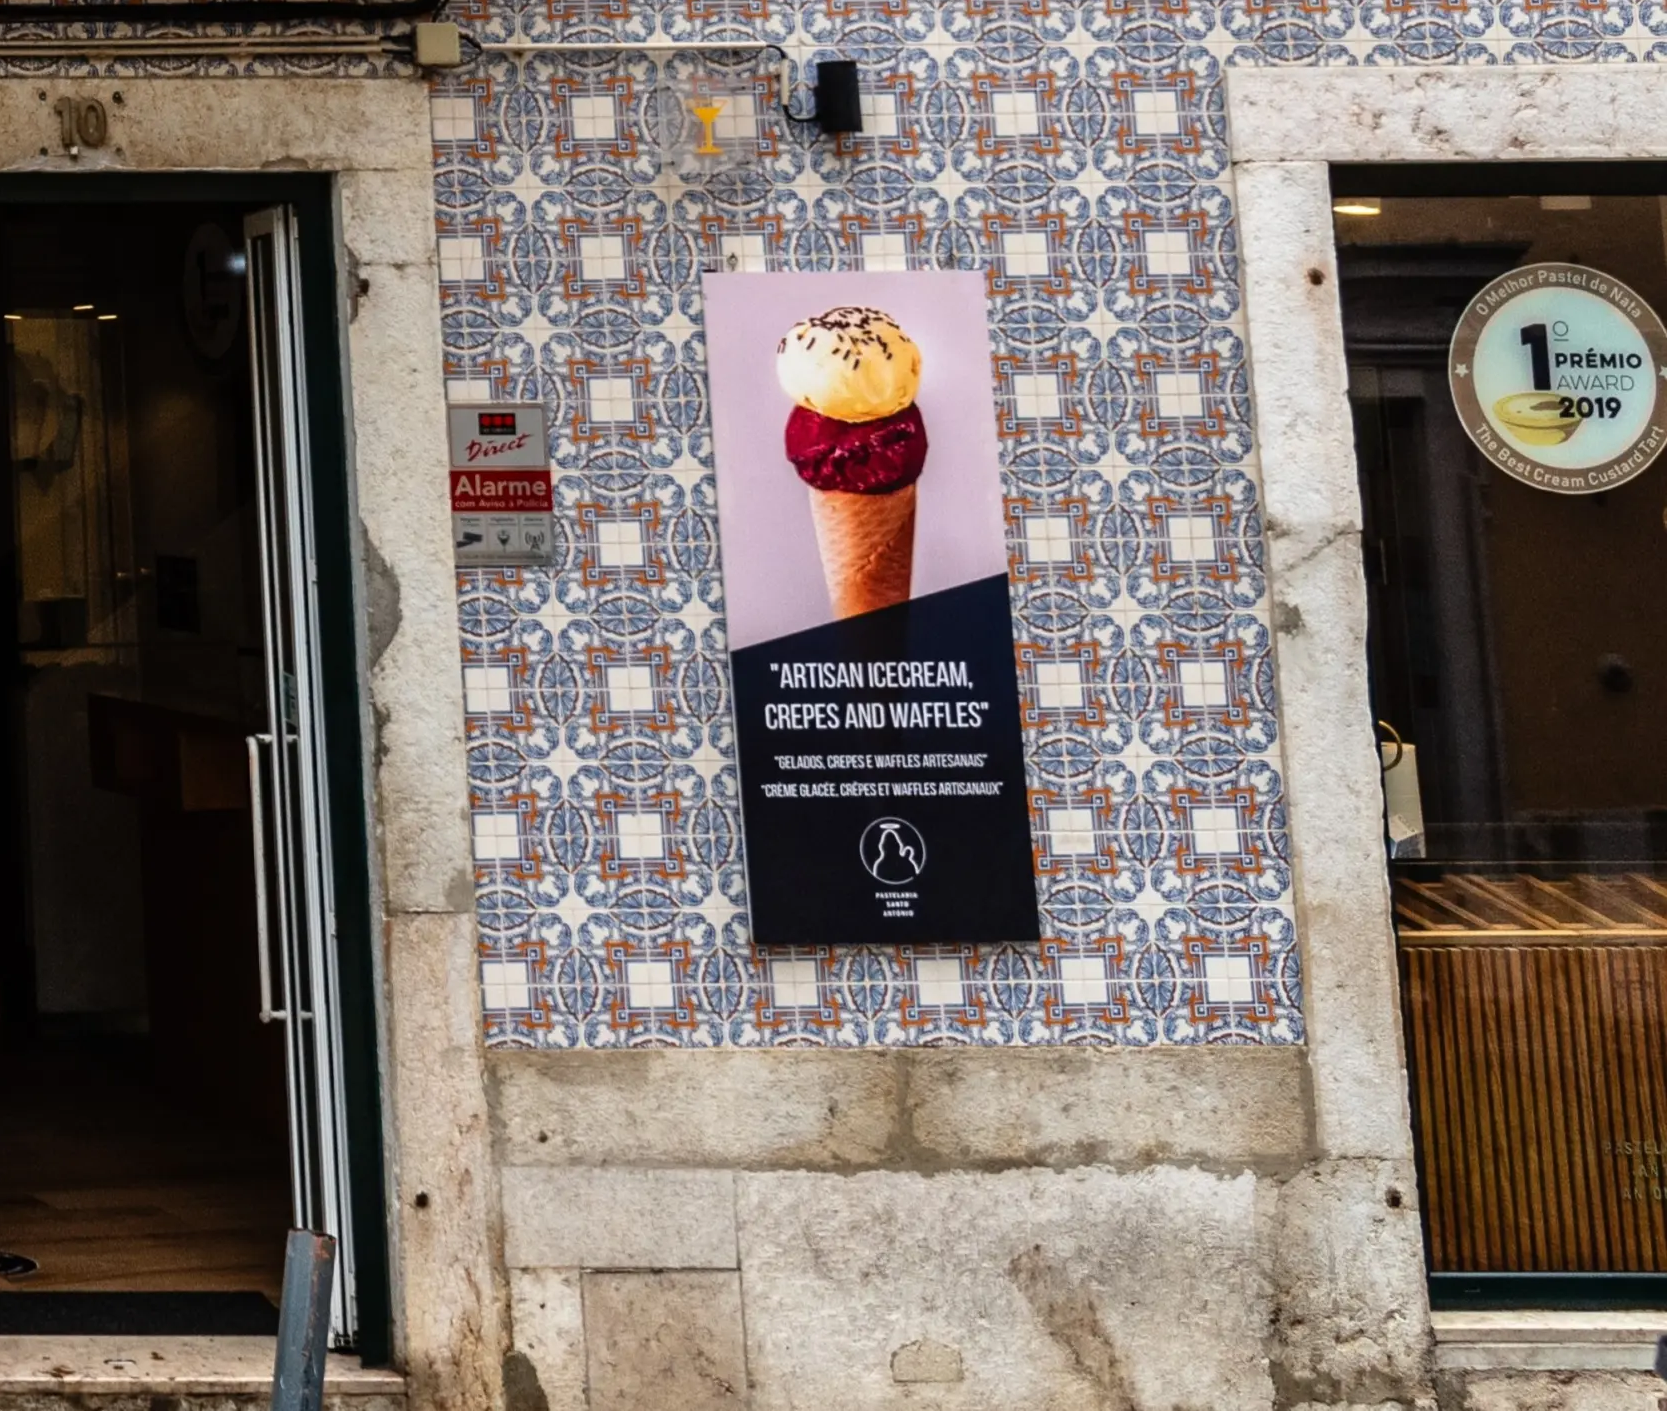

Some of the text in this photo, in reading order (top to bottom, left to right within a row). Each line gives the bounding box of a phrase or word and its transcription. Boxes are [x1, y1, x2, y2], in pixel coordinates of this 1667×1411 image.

[54, 96, 107, 150] 10
[1475, 270, 1642, 319] O Melhor Pastel de Nata
[1555, 347, 1642, 369] PRÉMIO
[1557, 375, 1635, 391] AWARD
[1558, 397, 1622, 419] 2019
[465, 432, 533, 462] Direct
[1474, 423, 1666, 488] The Best Cream Custard Tart
[455, 474, 547, 497] Alarme
[479, 499, 506, 508] Aviso
[868, 661, 973, 689] ICECREAM,
[765, 702, 989, 729] CREPES AND WAFFLES"
[827, 755, 865, 769] CREPES
[866, 755, 873, 769] E
[874, 754, 920, 768] WAFFLES
[878, 782, 889, 796] ET
[891, 782, 937, 796] WAFFLES
